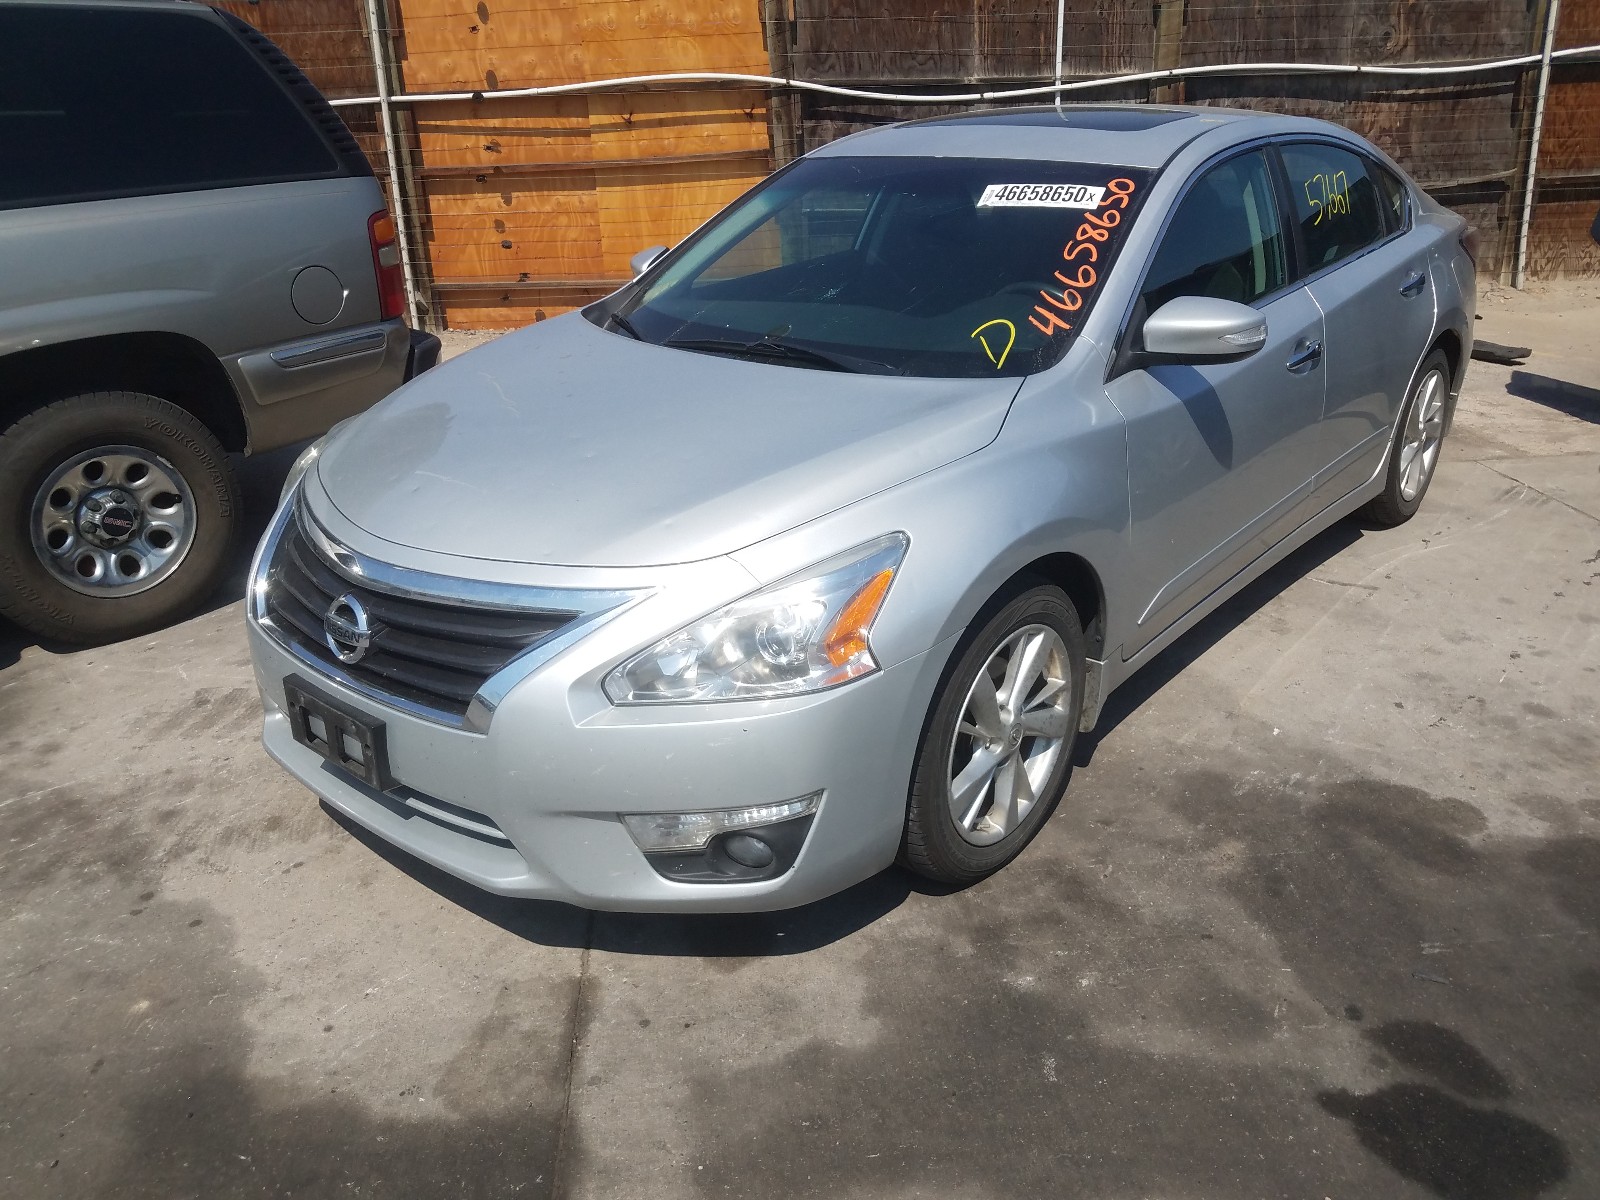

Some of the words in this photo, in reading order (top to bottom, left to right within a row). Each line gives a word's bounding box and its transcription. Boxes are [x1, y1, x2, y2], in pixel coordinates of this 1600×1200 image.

[1028, 178, 1136, 336] 46658650
[971, 318, 1016, 370] D
[144, 416, 231, 518] YOKOHAMA
